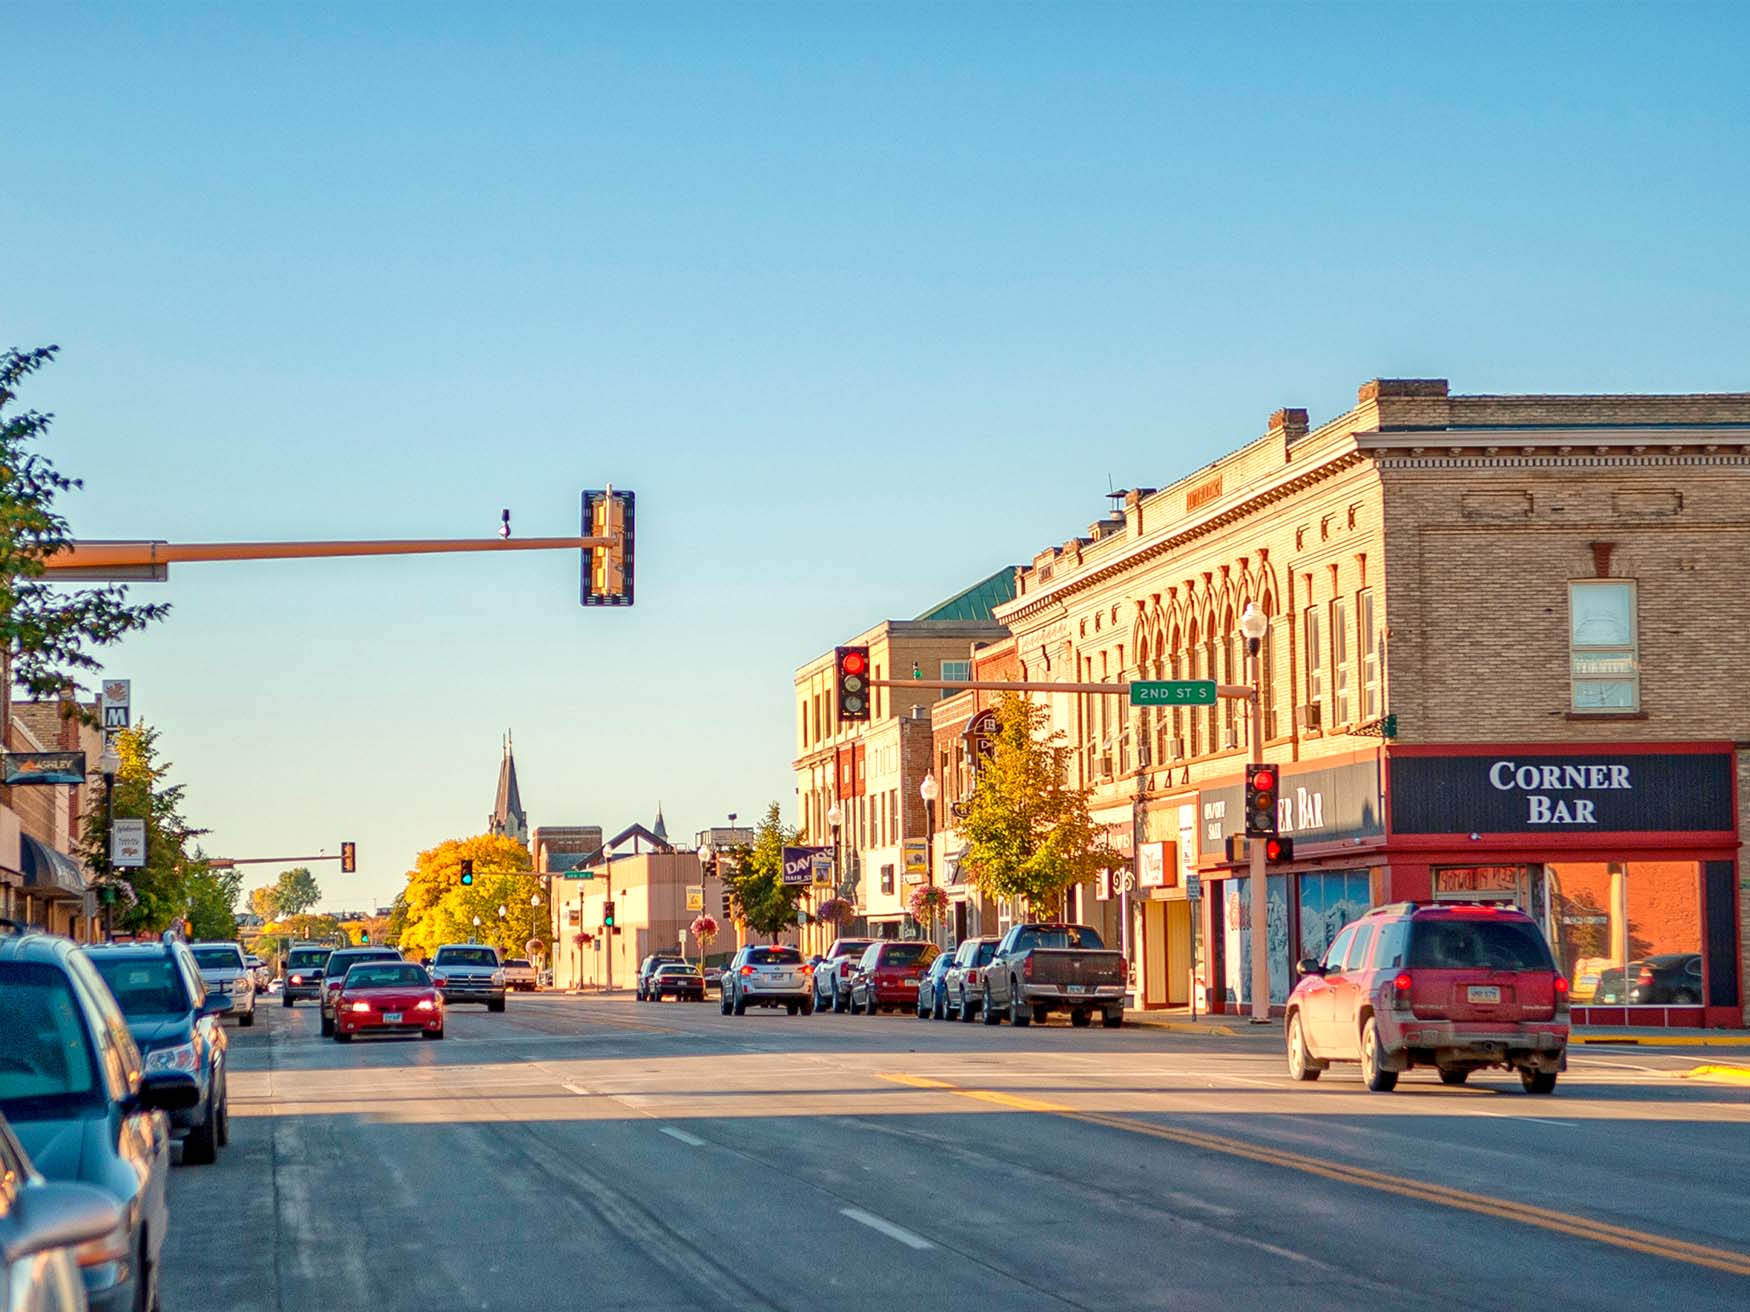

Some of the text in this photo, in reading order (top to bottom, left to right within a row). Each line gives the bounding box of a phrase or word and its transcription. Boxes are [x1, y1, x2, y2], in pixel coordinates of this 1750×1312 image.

[1140, 688, 1207, 698] 2ND ST S
[1489, 761, 1632, 790] CORNER
[1296, 787, 1324, 830] BAR
[1526, 796, 1597, 824] BAR
